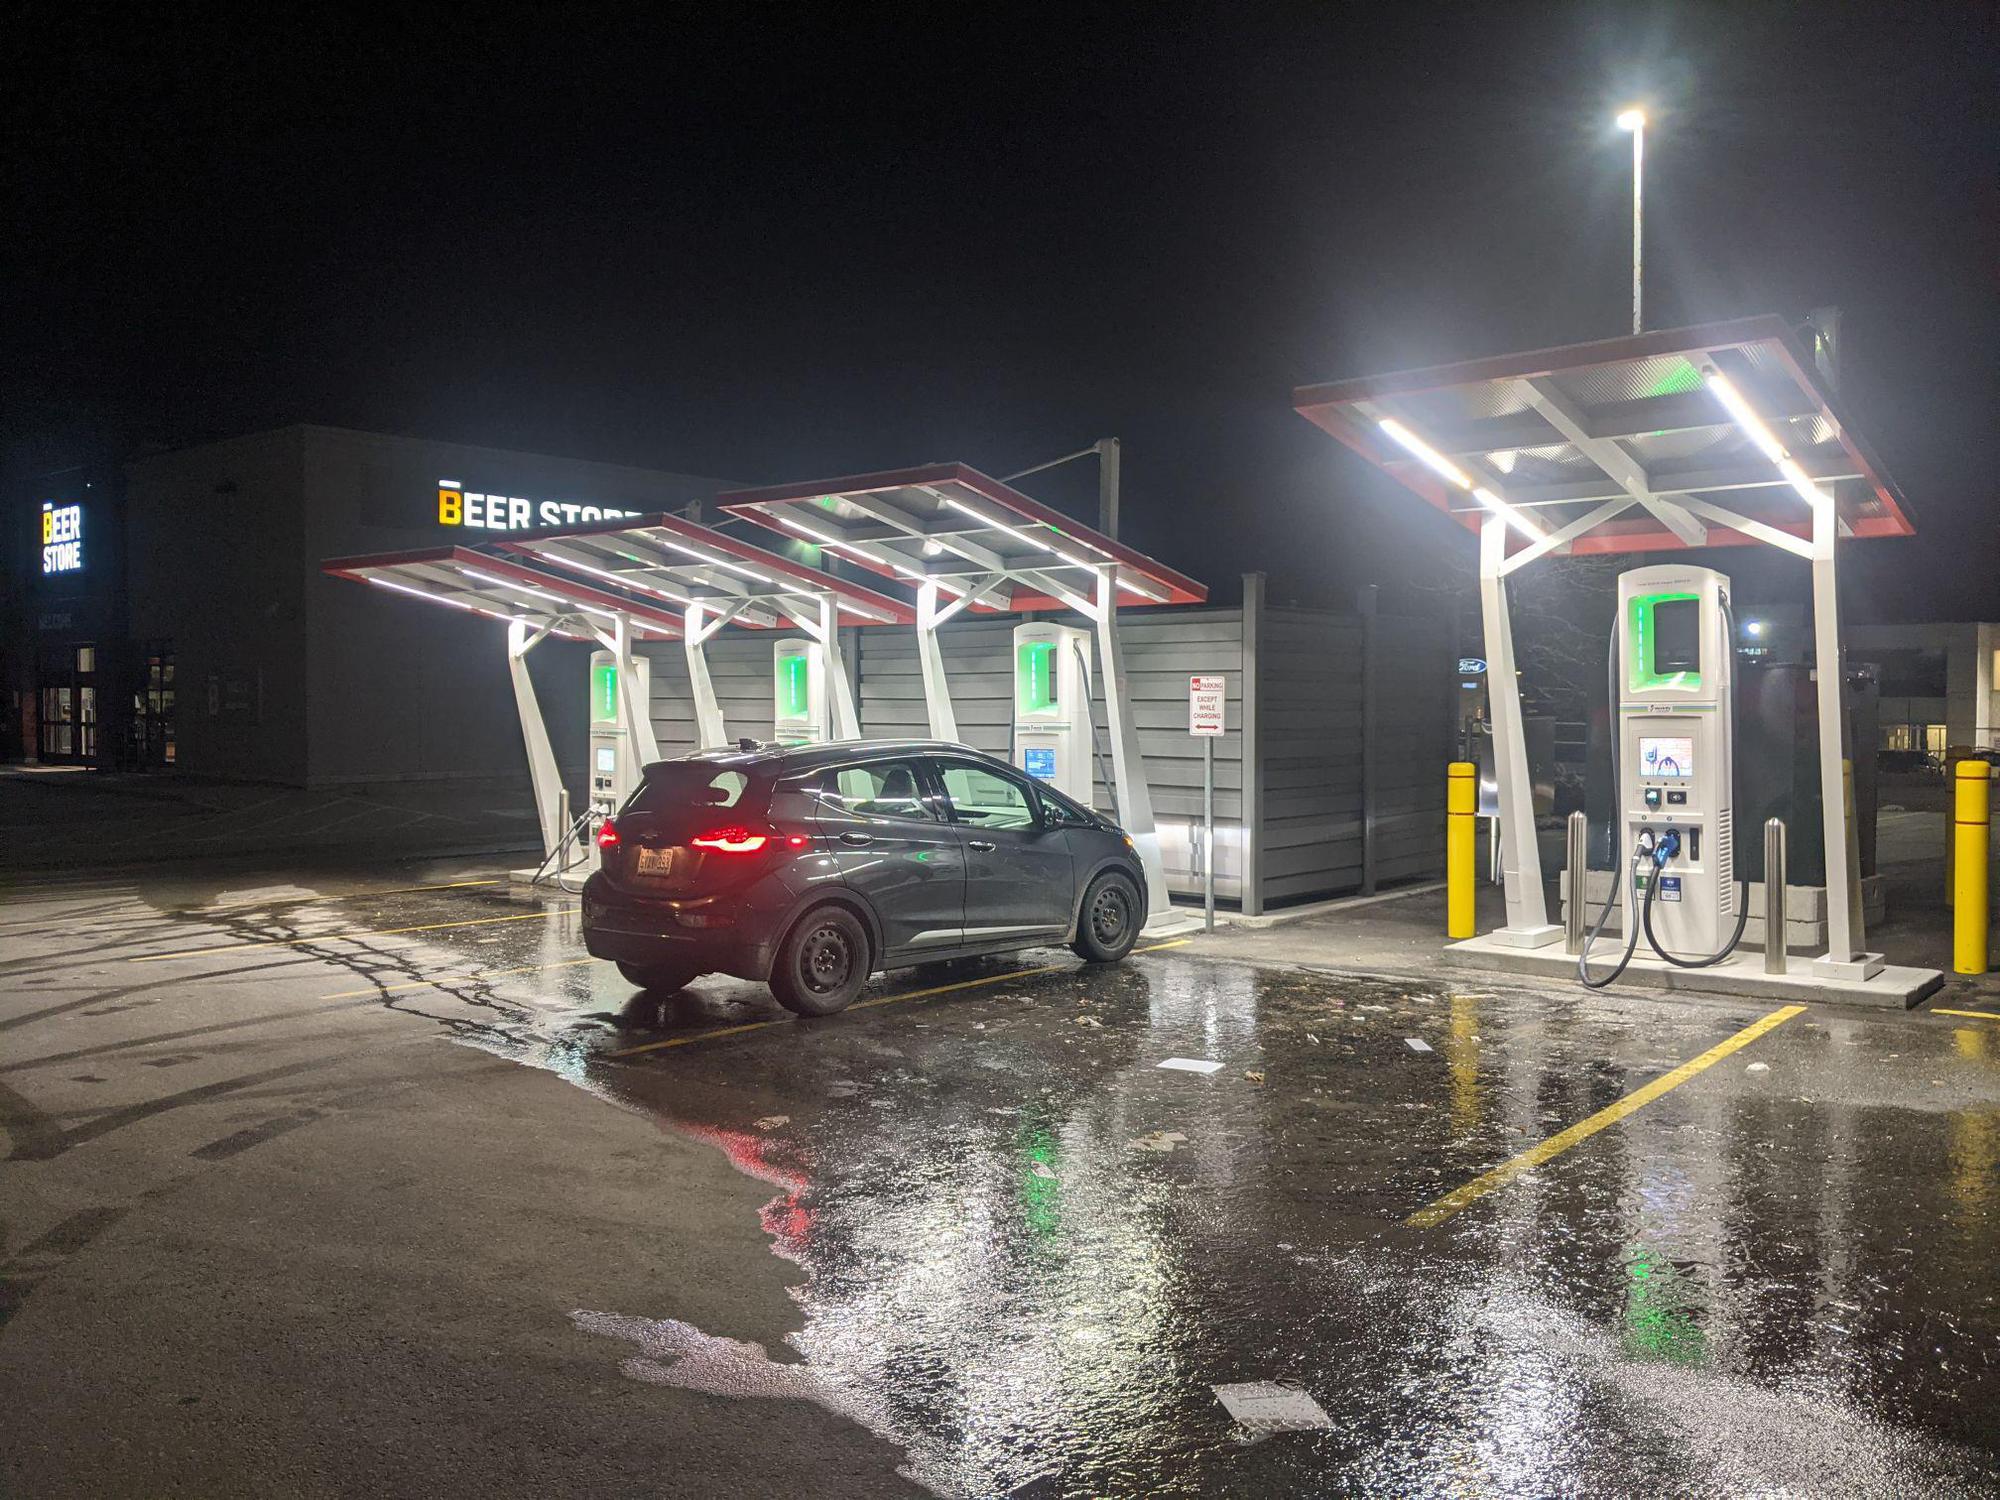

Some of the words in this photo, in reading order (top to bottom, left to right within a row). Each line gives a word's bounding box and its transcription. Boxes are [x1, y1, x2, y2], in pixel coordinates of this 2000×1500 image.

[43, 505, 81, 545] BEER
[438, 488, 531, 530] BEER
[540, 500, 643, 527] STO
[43, 541, 81, 573] STORE
[1197, 695, 1218, 703] EXCEPT
[1192, 712, 1222, 720] CHARGING
